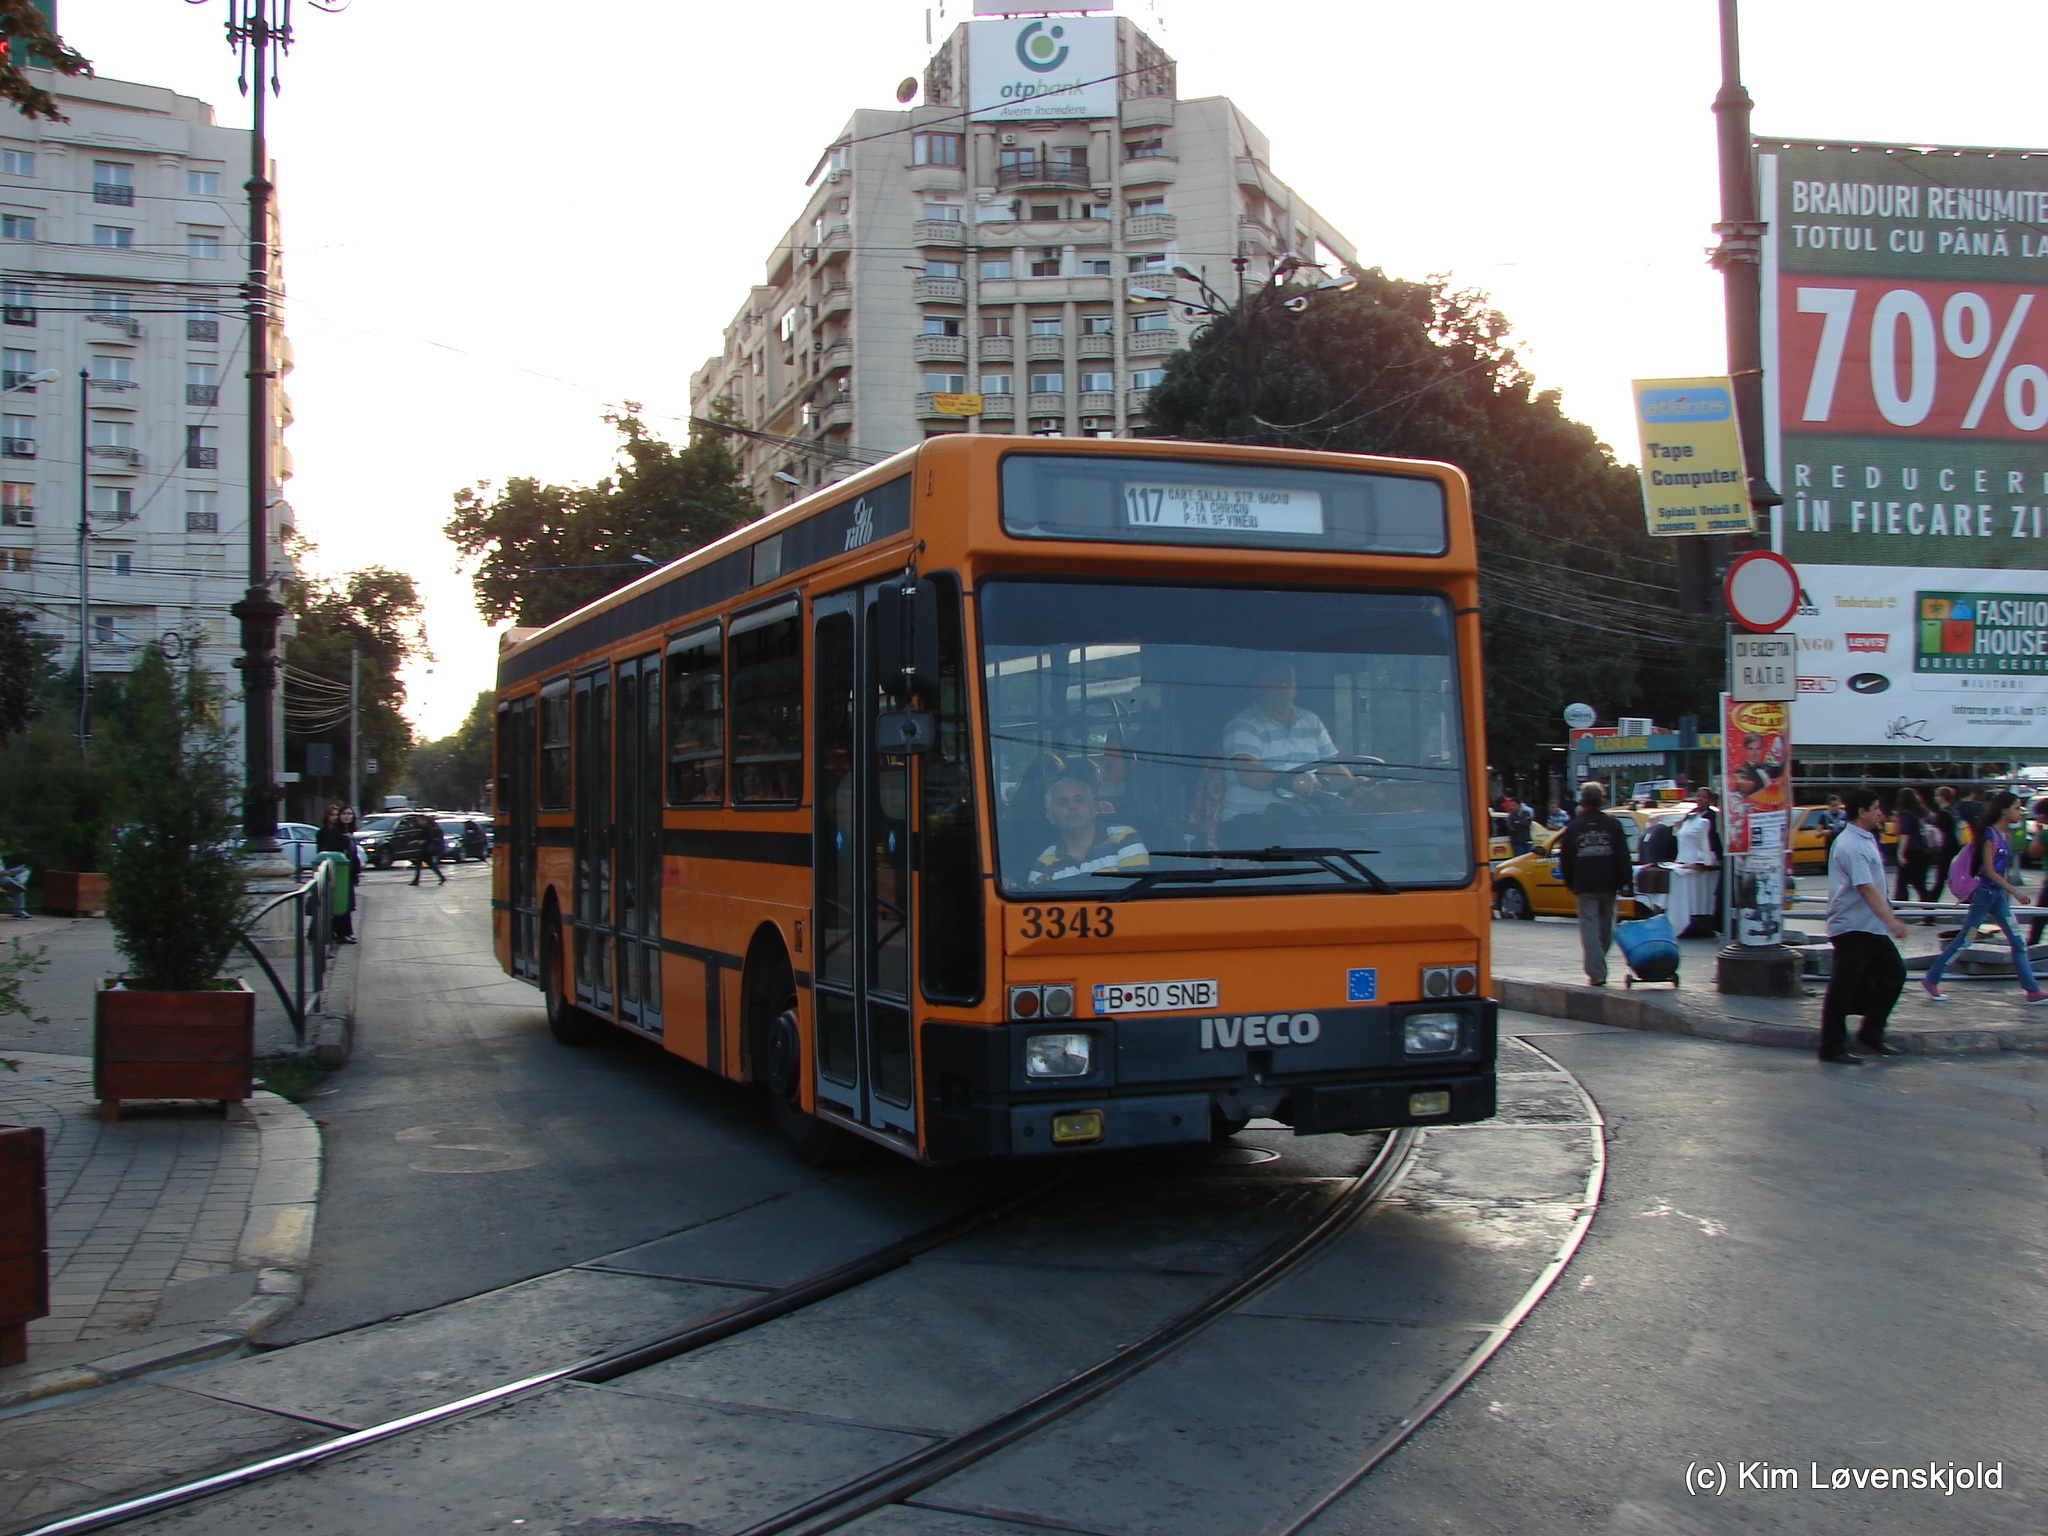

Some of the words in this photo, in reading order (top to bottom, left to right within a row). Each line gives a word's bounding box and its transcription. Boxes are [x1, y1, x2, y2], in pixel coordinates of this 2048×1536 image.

[1793, 181, 1919, 219] BRANDURI
[1928, 187, 2048, 223] RENUMITE
[1792, 225, 1877, 251] TOTUL
[1889, 229, 1925, 254] CU
[1938, 226, 2010, 257] PÂNĂ
[2021, 234, 2048, 258] LA
[1796, 287, 2048, 432] 70%
[1647, 443, 1693, 462] Tape
[1651, 469, 1738, 488] Computer
[1127, 488, 1164, 523] 117
[1794, 494, 1830, 531] ÎN
[1850, 502, 1993, 537] FIECARE
[2010, 505, 2048, 538] ZI
[1975, 629, 2048, 656] HOUSE
[1920, 657, 1988, 669] OUTLET
[1020, 906, 1114, 939] 3343
[1166, 982, 1211, 1007] SNB
[1200, 1013, 1320, 1050] IVECO
